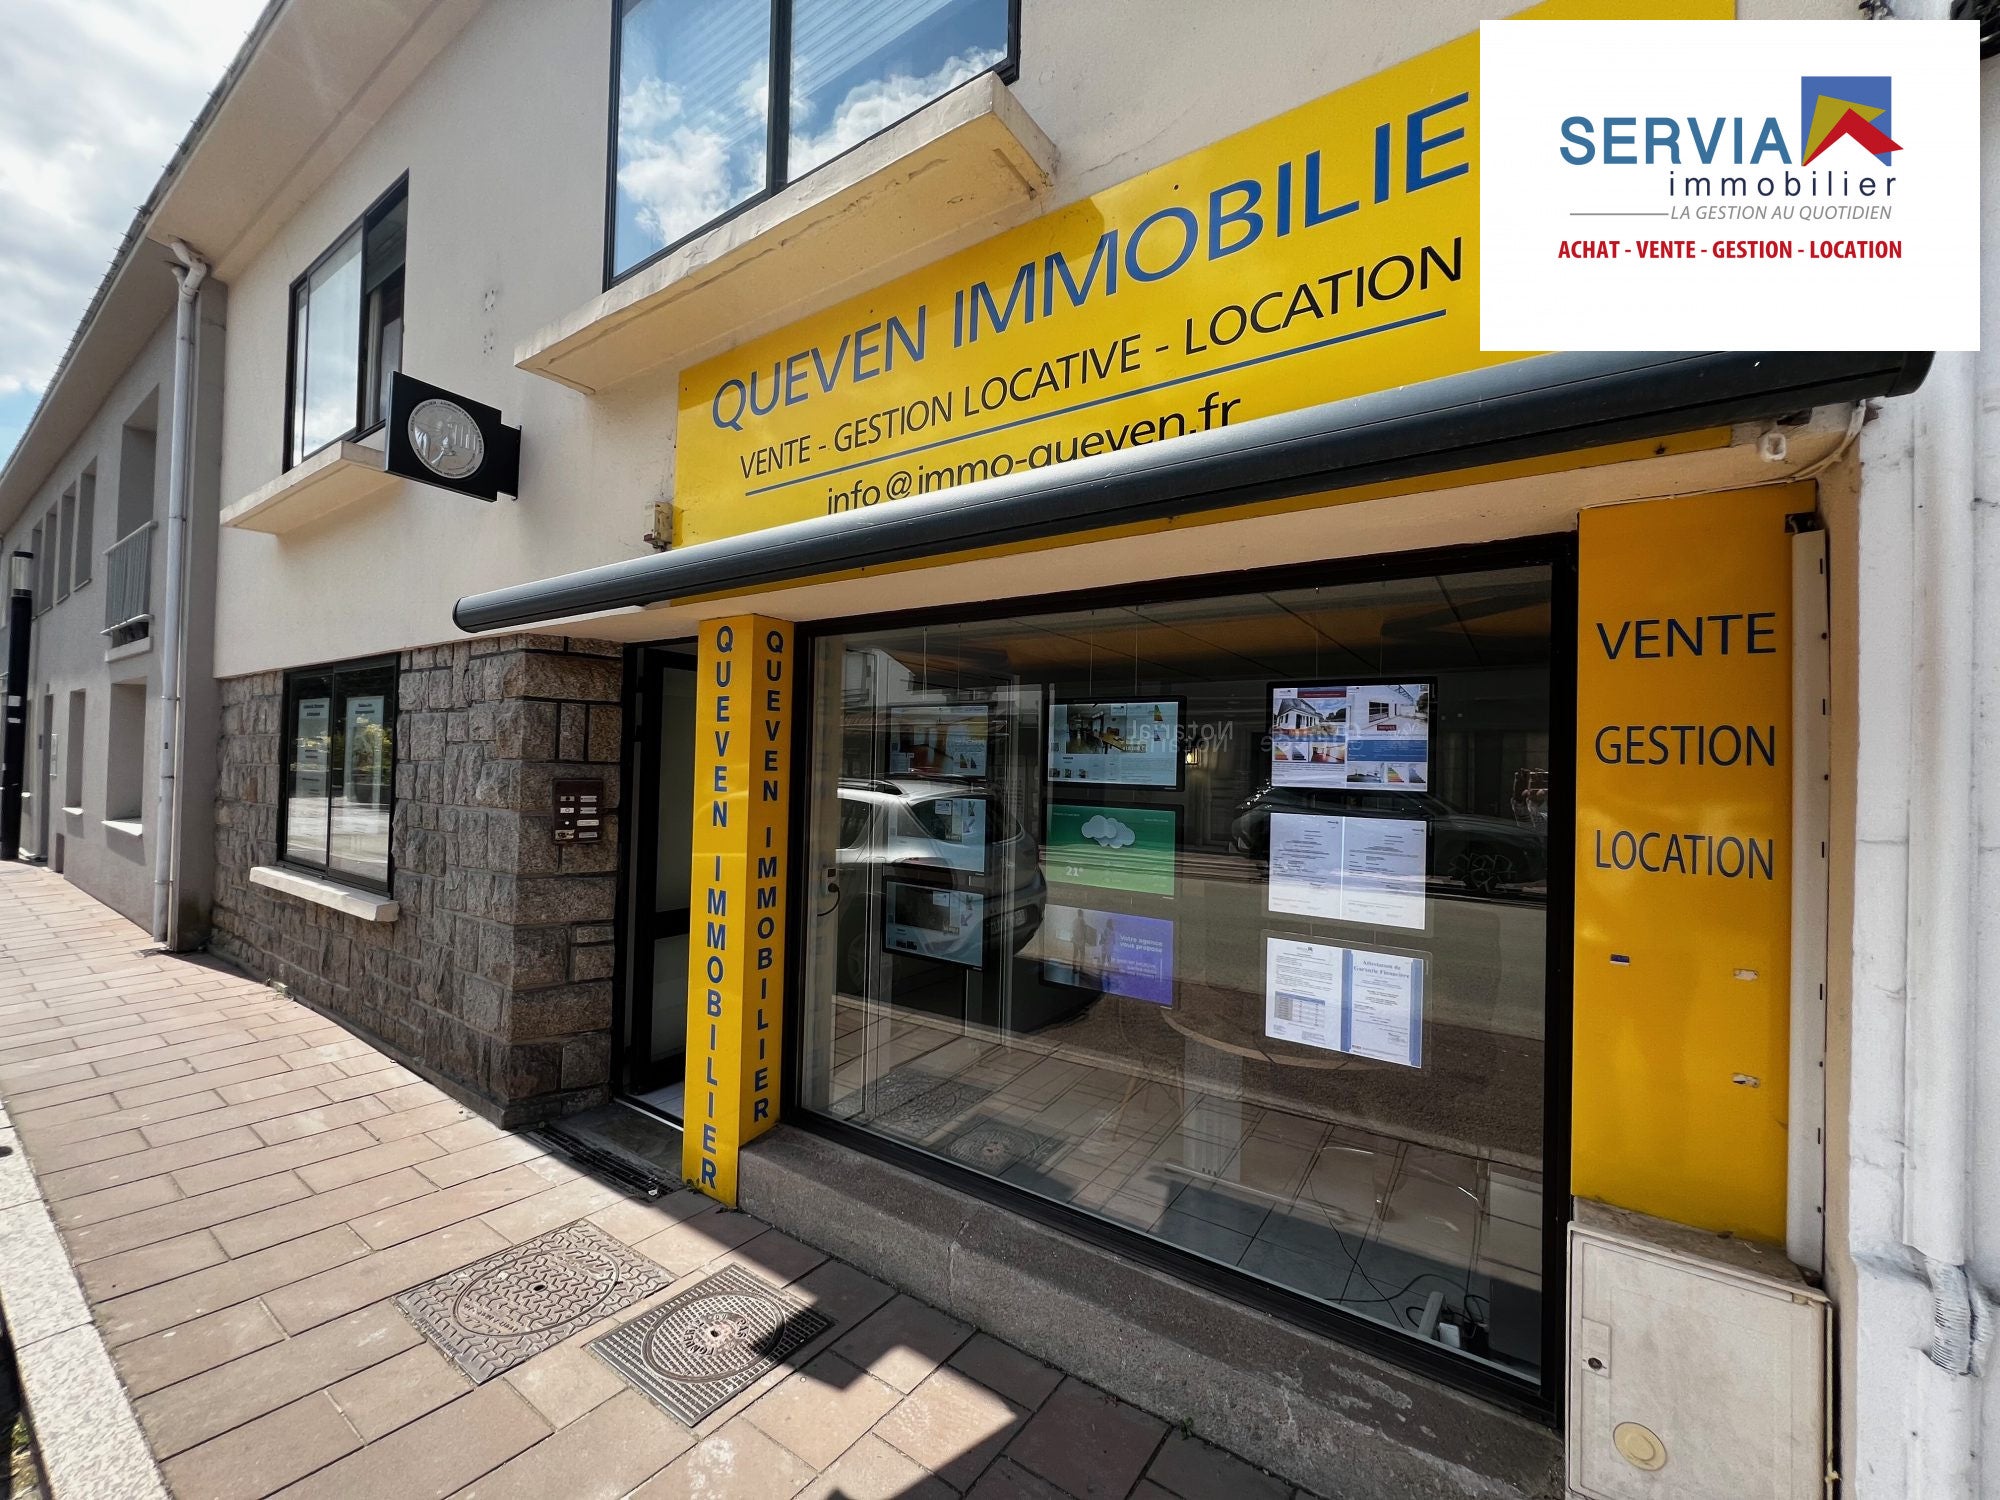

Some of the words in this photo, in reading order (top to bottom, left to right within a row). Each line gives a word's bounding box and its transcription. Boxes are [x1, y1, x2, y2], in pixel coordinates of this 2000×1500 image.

[711, 304, 927, 432] QUEVEN
[740, 436, 812, 479] VENTE
[834, 396, 953, 454] GESTION
[963, 333, 1142, 418] LOCATIVE
[1185, 237, 1462, 352] LOCATION
[762, 630, 784, 802] QUEVEN
[1596, 612, 1777, 660] VENTE
[712, 625, 734, 828] QUEVEN
[1595, 724, 1776, 767] GESTION
[1595, 829, 1774, 881] LOCATION
[701, 855, 728, 1190] IMMOBILIER
[754, 826, 778, 1123] IMMOBILIER
